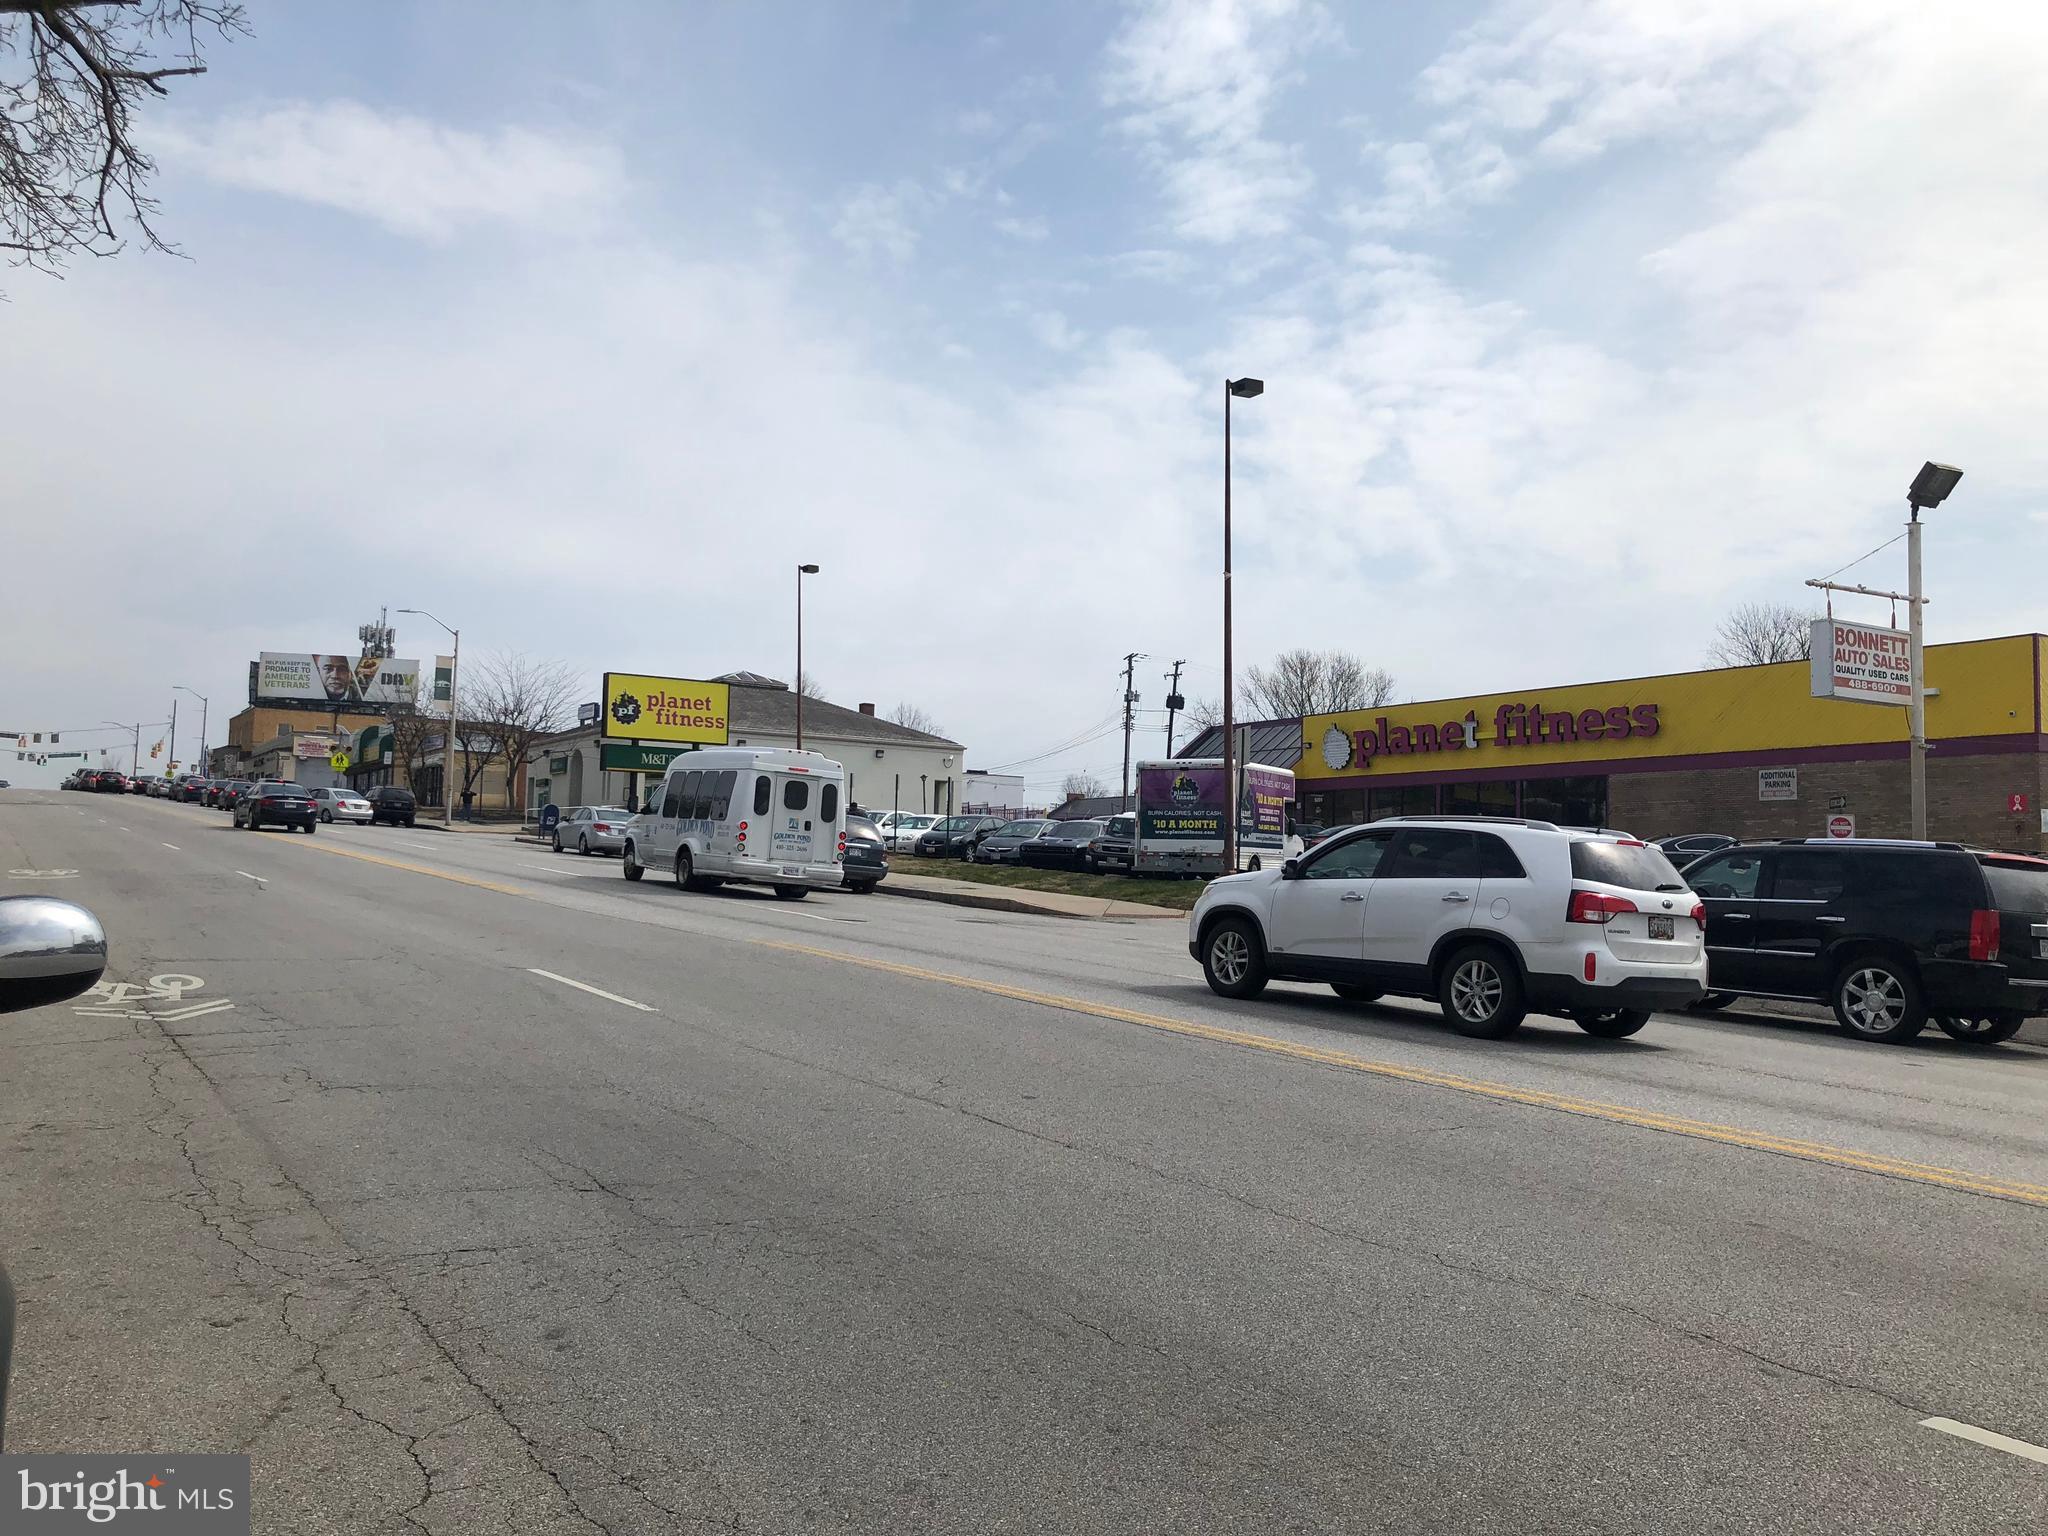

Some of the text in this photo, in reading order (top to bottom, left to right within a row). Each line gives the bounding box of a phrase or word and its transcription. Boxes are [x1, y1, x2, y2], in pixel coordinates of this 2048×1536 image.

[1835, 626, 1908, 656] BONNETT
[1834, 647, 1910, 672] AUTO SALES
[265, 665, 299, 673] PROMISE
[1835, 664, 1909, 682] QUALITY USED CARS
[265, 673, 311, 681] AMERICA'S
[265, 680, 310, 688] VETERANS
[1848, 680, 1897, 693] 488-6900
[647, 691, 712, 711] planet
[618, 704, 636, 716] pf
[656, 708, 725, 729] fitness
[1353, 703, 1660, 768] planet fitness
[641, 753, 669, 765] M&T
[1760, 771, 1795, 780] ADDITIONAL
[1764, 780, 1791, 788] PARKING
[1153, 820, 1217, 828] $10 A MONTH
[774, 832, 796, 841] GOLDEN
[797, 834, 812, 843] POND
